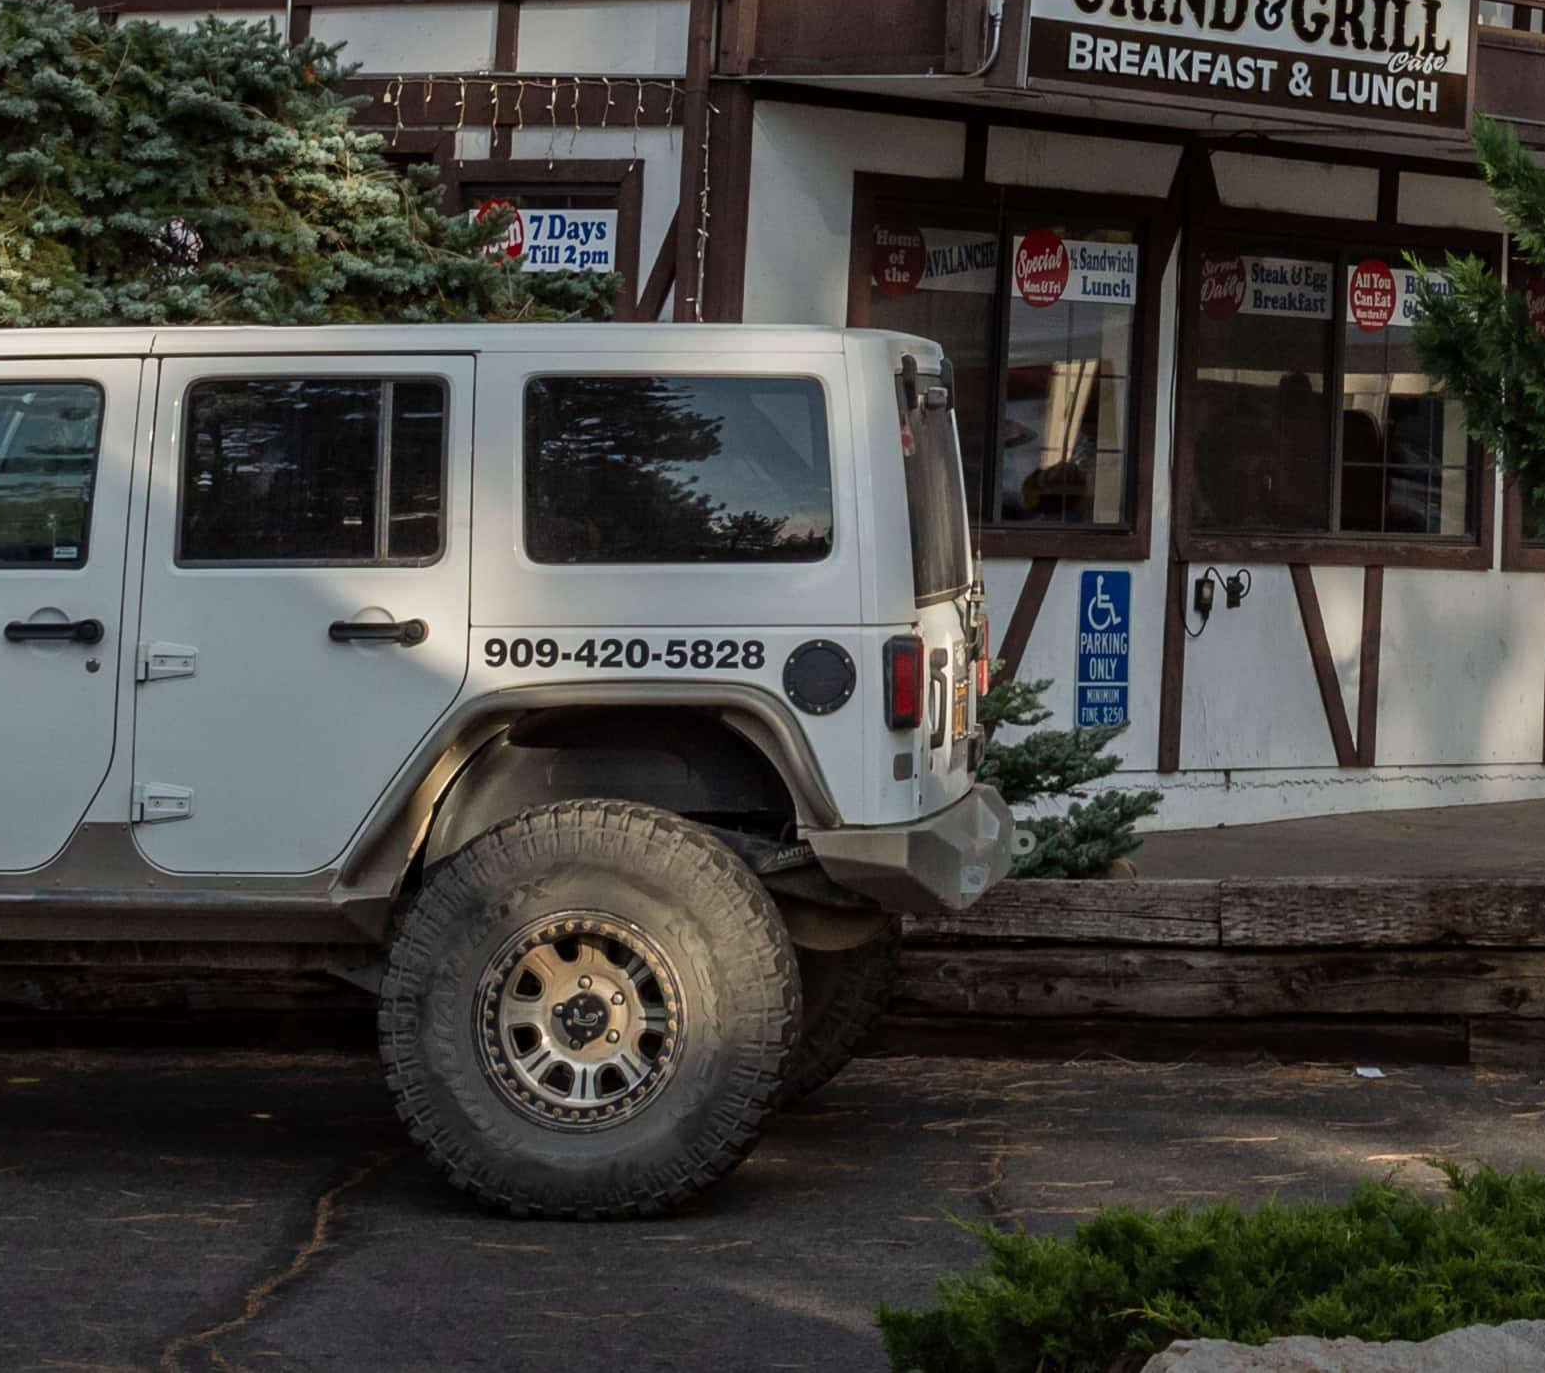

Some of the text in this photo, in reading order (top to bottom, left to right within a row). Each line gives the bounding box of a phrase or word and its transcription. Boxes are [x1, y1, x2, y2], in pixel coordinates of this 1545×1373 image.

[1068, 32, 1438, 113] BREAKFAST & LUNCH
[1388, 52, 1446, 73] Cafe
[529, 215, 544, 240] 7
[547, 214, 607, 246] Days
[875, 228, 920, 247] Home
[529, 245, 609, 268] Till 2 pm
[889, 250, 905, 265] of
[1017, 245, 1064, 278] Special
[1079, 247, 1134, 273] Sandwich
[884, 267, 911, 283] the
[1081, 275, 1130, 298] Lunch
[1251, 262, 1328, 292] Steak & Egg
[1355, 272, 1391, 290] All You
[1201, 275, 1245, 303] Daily
[1354, 290, 1391, 308] Can Eat
[1253, 290, 1326, 313] Breakfast
[484, 638, 765, 670] 909-420-5828
[1080, 632, 1128, 655] PARKING
[1089, 657, 1117, 680] ONLY
[1087, 688, 1119, 703] MINIMUM
[1081, 707, 1124, 724] FINE $250
